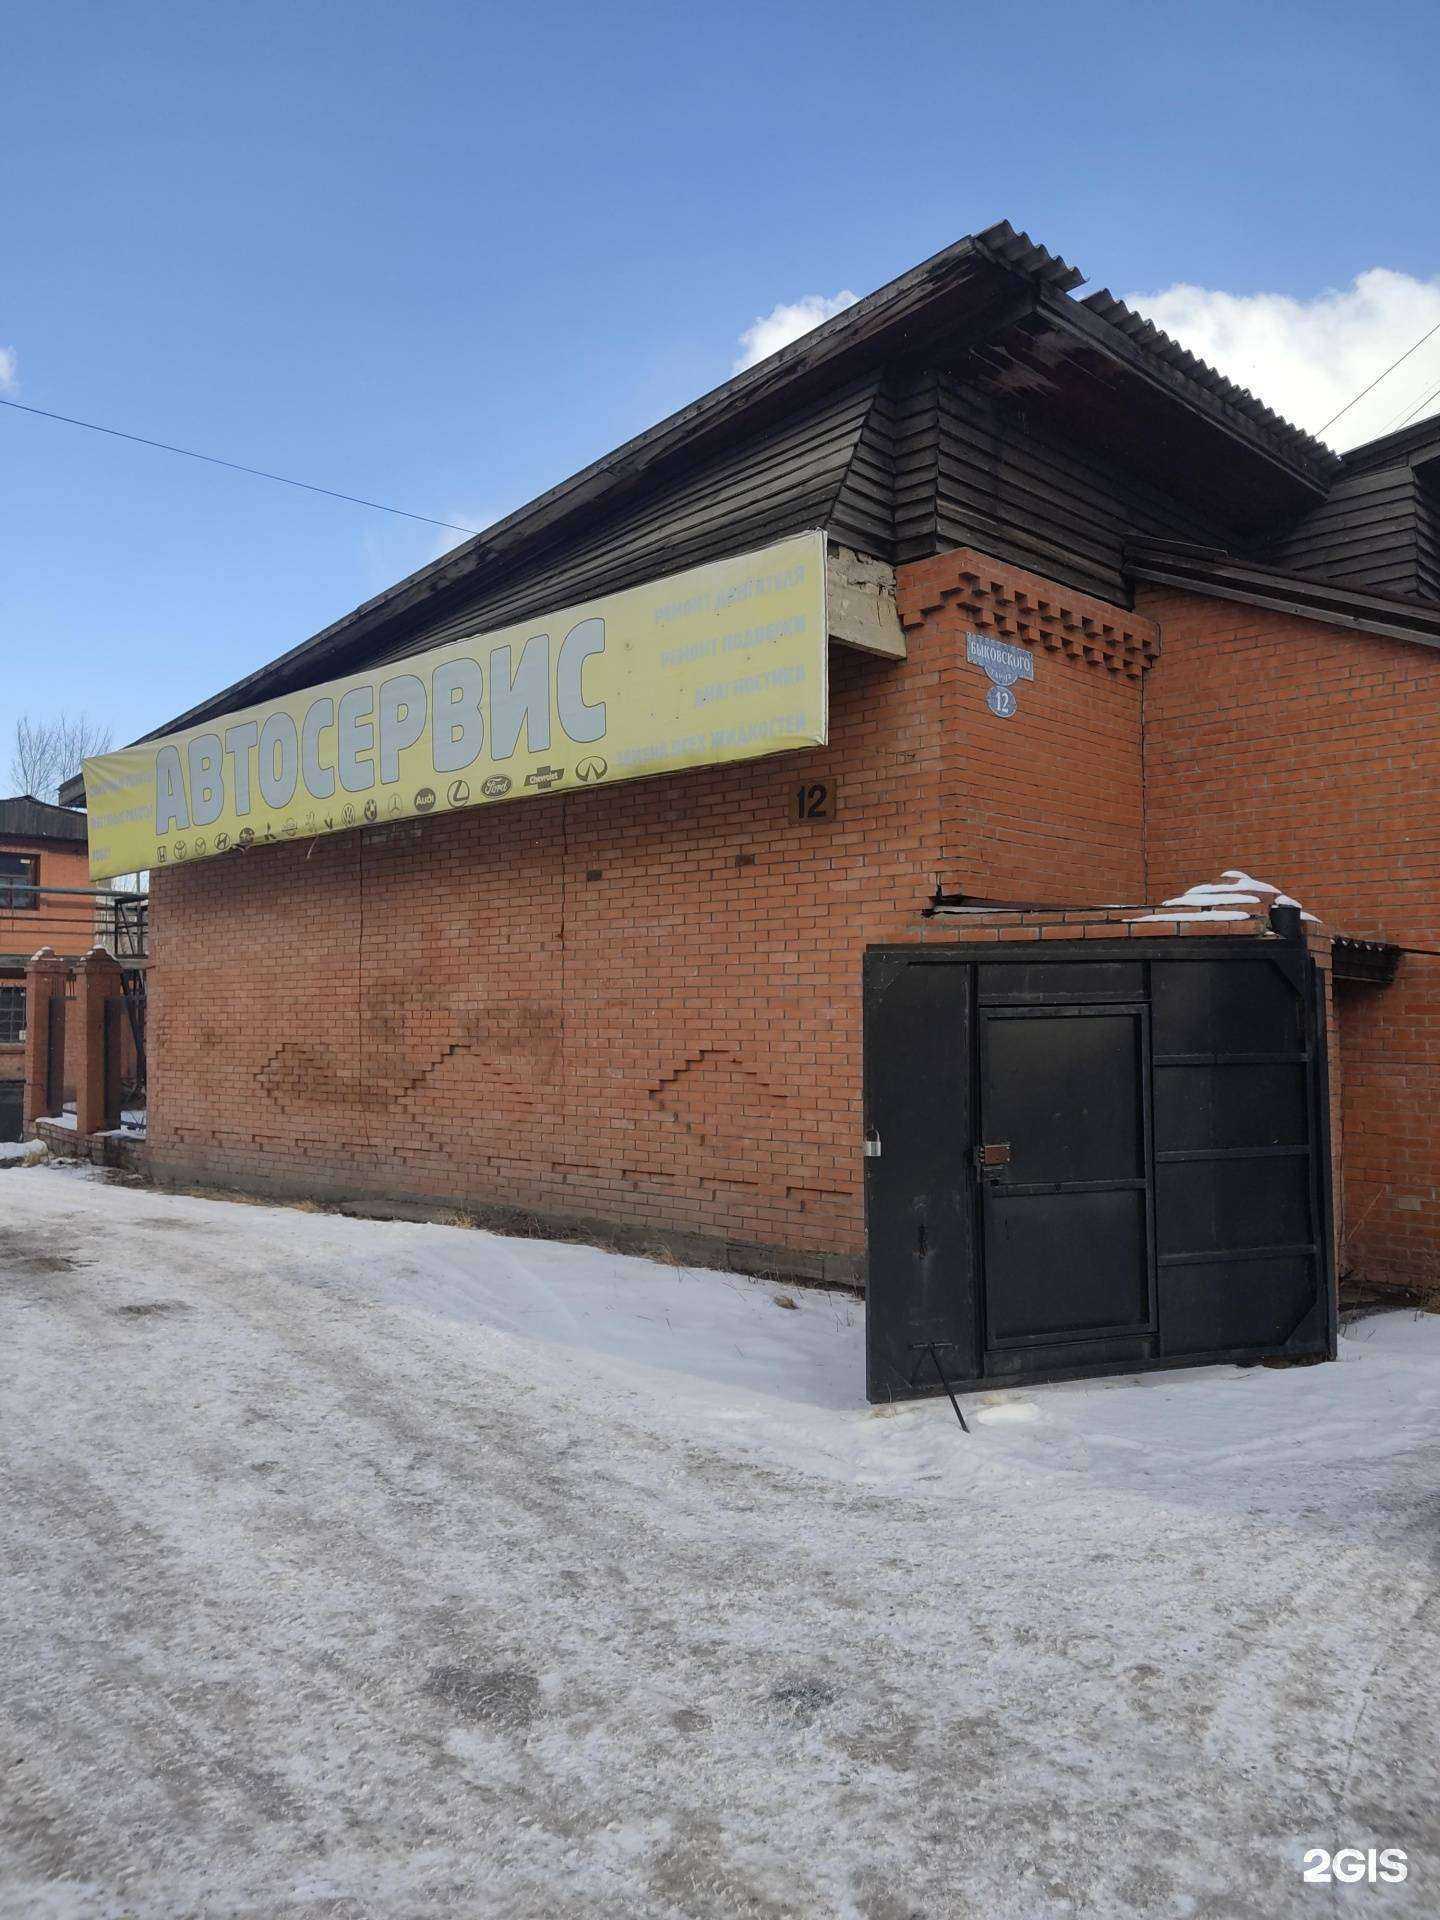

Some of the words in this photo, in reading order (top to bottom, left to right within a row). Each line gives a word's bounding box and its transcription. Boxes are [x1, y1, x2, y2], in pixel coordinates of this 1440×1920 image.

[971, 641, 1030, 672] БЫКОВСКОГО
[995, 692, 1009, 713] 12
[155, 617, 607, 836] АВТОСЕРВИС
[484, 778, 509, 795] Ford
[416, 794, 434, 806] Audi
[797, 783, 827, 819] 12
